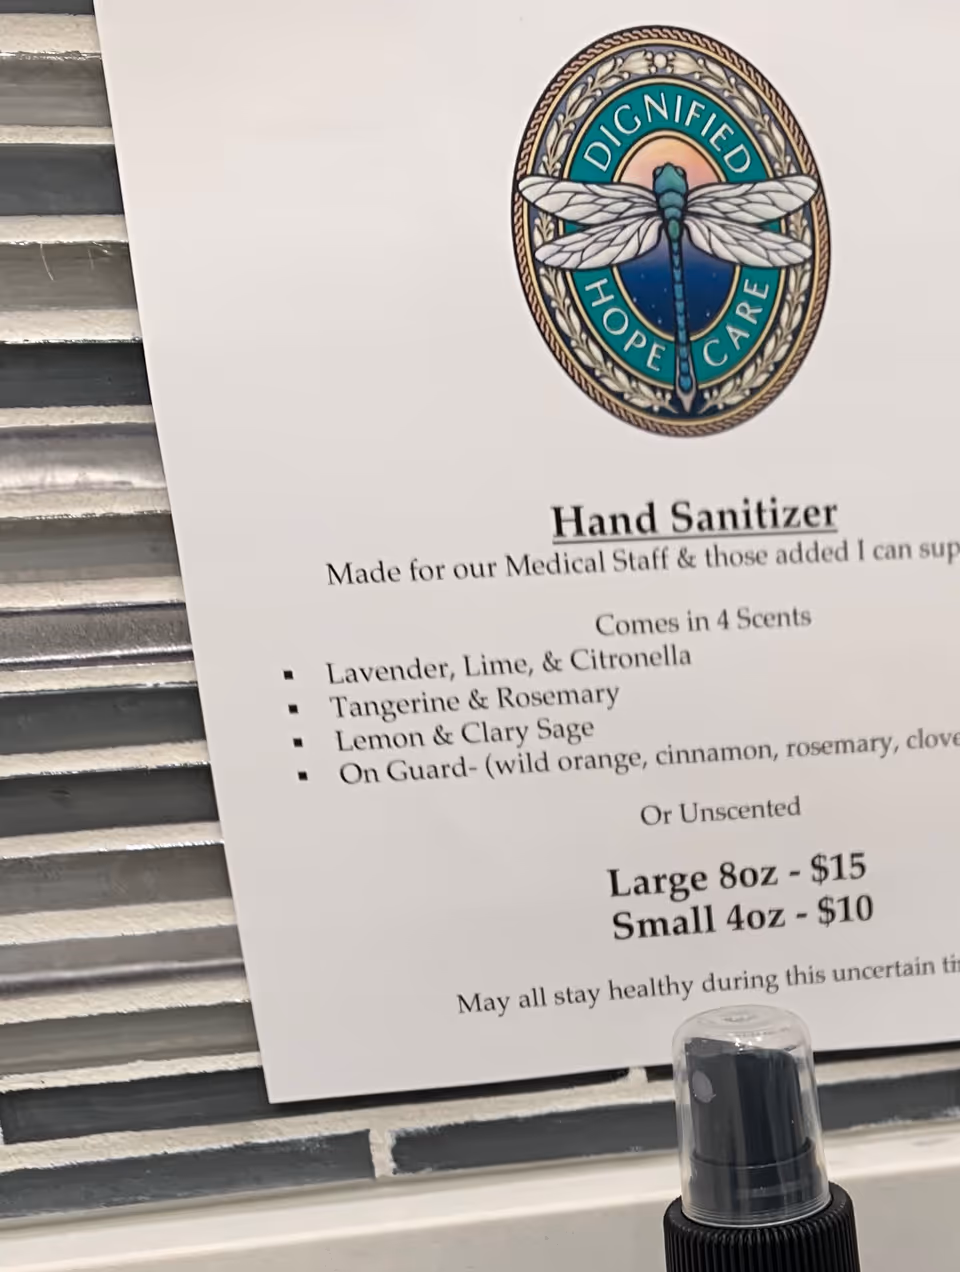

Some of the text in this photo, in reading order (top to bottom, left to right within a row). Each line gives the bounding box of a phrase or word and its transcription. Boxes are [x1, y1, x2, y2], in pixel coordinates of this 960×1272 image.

[583, 92, 750, 173] DIGNIFIED
[585, 278, 769, 372] HOPE CARE
[550, 495, 838, 538] Hand Sanitizer
[326, 560, 401, 585] Made
[410, 558, 445, 581] for
[453, 562, 497, 580] our
[505, 550, 605, 577] Medical
[613, 546, 668, 572] Staff
[677, 547, 696, 569] &
[705, 544, 768, 568] those
[776, 539, 848, 564] added
[858, 539, 864, 561] I
[873, 544, 912, 560] can
[596, 607, 812, 636] Comes in 4 Scents
[326, 643, 691, 684] Lavender, Lime, & Citronella
[329, 687, 619, 723] Tangerine & Rosemary
[335, 718, 594, 751] Lemon & Clary Sage
[340, 763, 380, 784] On
[387, 756, 477, 782] Guard-
[485, 751, 550, 779] (wild
[558, 752, 647, 775] orange,
[656, 744, 778, 765] cinnamon,
[786, 737, 899, 759] rosemary,
[640, 795, 801, 825] Or Unscented
[607, 869, 708, 902] Large
[719, 861, 778, 889] 8oz
[811, 852, 866, 886] $15
[613, 904, 716, 940] Small
[727, 904, 785, 931] 4oz
[818, 894, 873, 928] $10
[457, 993, 510, 1017] May
[519, 987, 547, 1008] all
[554, 987, 600, 1009] stay
[608, 975, 693, 1001] healthy
[702, 970, 779, 994] during
[786, 965, 826, 986] this
[832, 957, 935, 982] uncertain
